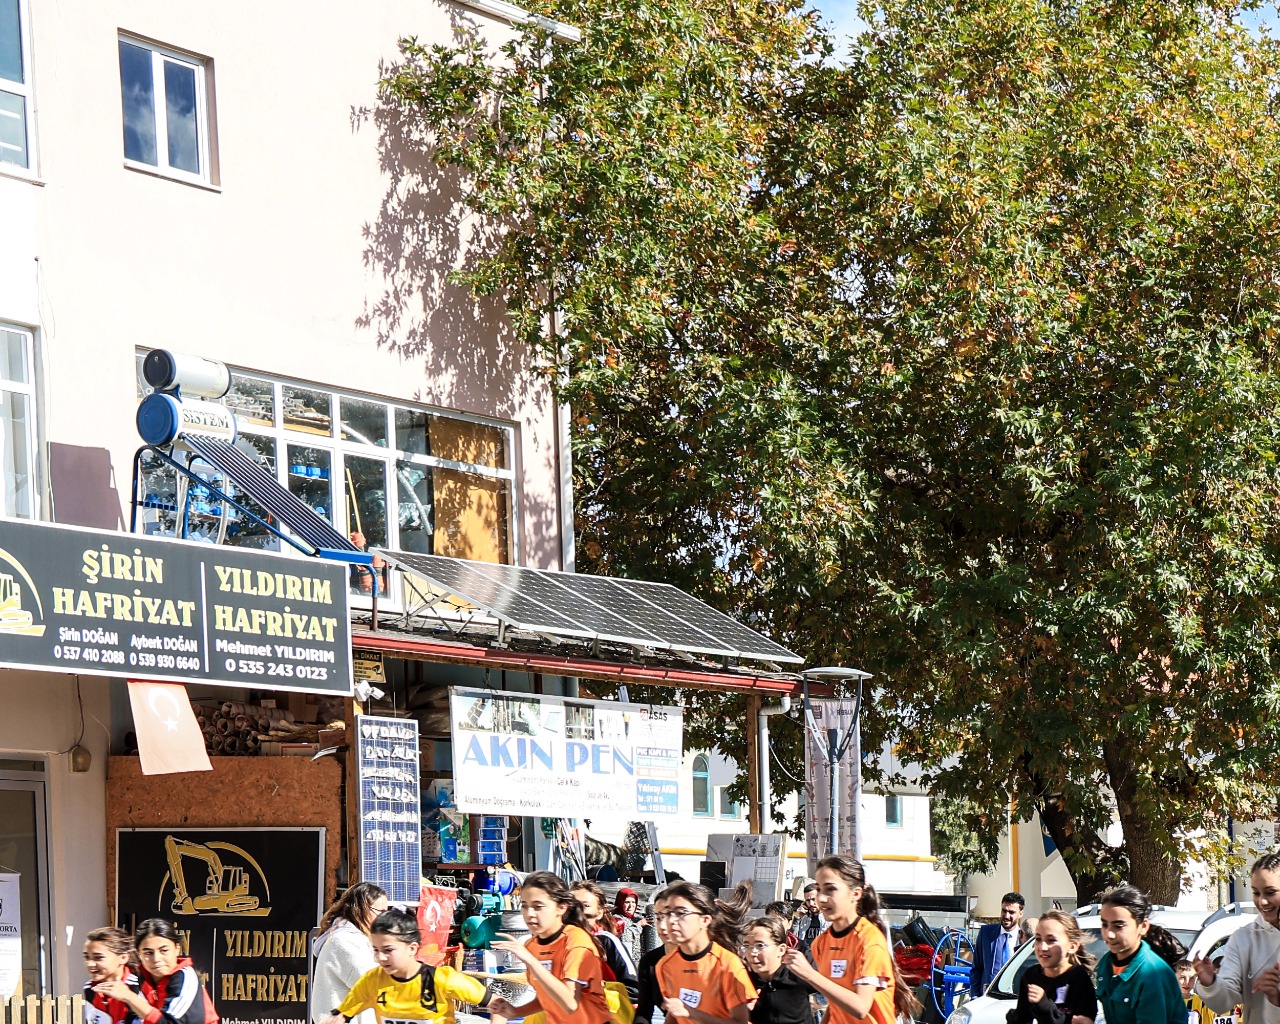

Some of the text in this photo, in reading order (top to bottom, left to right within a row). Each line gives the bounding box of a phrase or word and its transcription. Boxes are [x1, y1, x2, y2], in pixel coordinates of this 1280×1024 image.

[82, 544, 163, 584] ŞİRİN
[214, 566, 332, 604] YILDIRIM
[53, 587, 195, 627] HAFRİYAT
[59, 627, 118, 645] Şirin DOĞAN
[215, 606, 337, 642] HAFRİYAT
[54, 645, 125, 664] 0 537 410 2088
[130, 634, 198, 652] Ayberk DOĞAN
[215, 639, 334, 663] Mehmet YILDIRIM
[130, 652, 200, 670] 0 539 930 6640
[225, 659, 328, 680] 0 535 243 0123
[462, 734, 553, 776] AKIN
[565, 740, 634, 776] PEN
[223, 929, 308, 958] YILDIRIM
[221, 966, 309, 1002] HAFRİYAT
[376, 991, 387, 1007] 4
[683, 992, 698, 1004] 223
